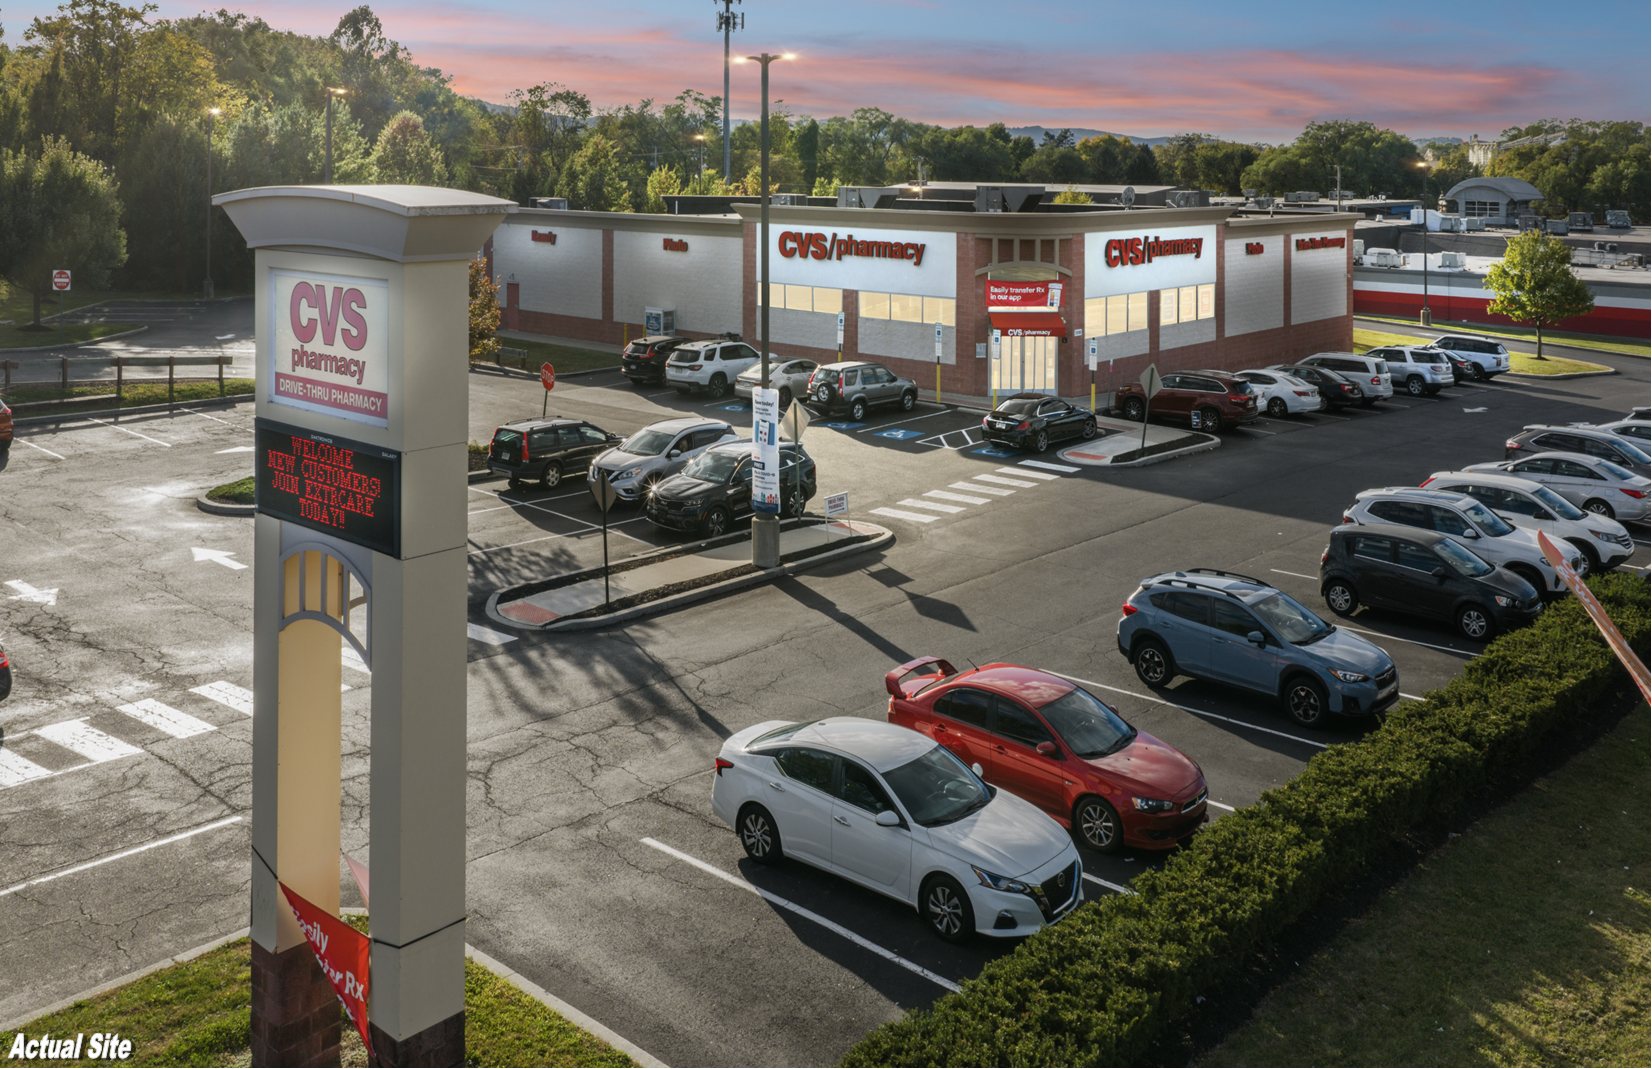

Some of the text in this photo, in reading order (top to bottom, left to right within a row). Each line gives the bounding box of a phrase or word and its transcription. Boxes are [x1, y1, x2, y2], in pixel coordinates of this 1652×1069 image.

[663, 238, 688, 252] Photo
[779, 231, 926, 266] CVS/pharmacy
[1105, 236, 1204, 268] CVS/pharmacy
[990, 286, 1008, 294] Easily
[290, 281, 368, 351] CVS
[292, 344, 366, 385] pharmacy
[541, 368, 554, 385] STOP
[279, 378, 382, 412] DRIVE-THRU PHARMACY
[291, 436, 353, 469] WELCOME
[268, 449, 381, 498] NEW CUSTOMERS!
[272, 470, 374, 517] JOIN EXTRCARE
[344, 970, 364, 1002] Rx
